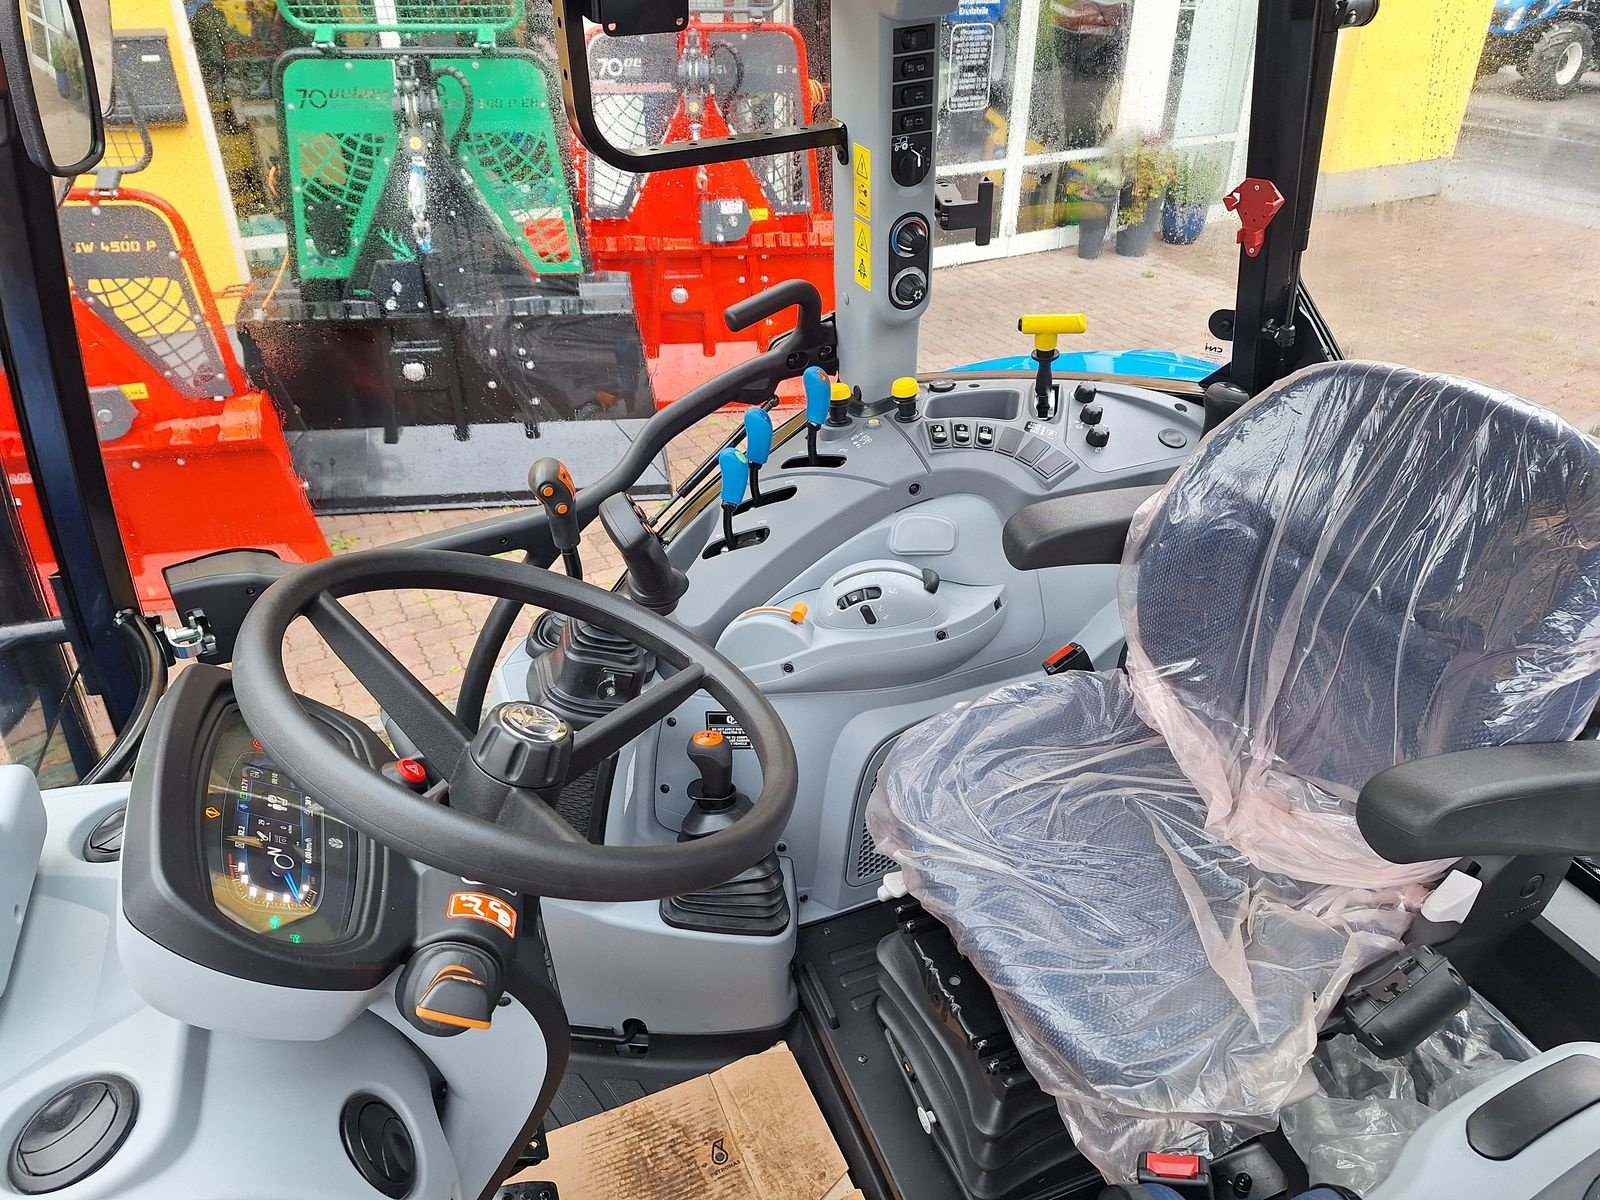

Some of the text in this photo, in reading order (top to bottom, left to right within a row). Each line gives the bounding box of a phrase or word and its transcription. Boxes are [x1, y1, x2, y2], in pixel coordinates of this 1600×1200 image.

[295, 88, 328, 109] 70
[101, 240, 140, 252] 4500
[147, 239, 157, 251] P
[267, 846, 283, 856] N
[710, 1159, 741, 1178] PETRONAS
